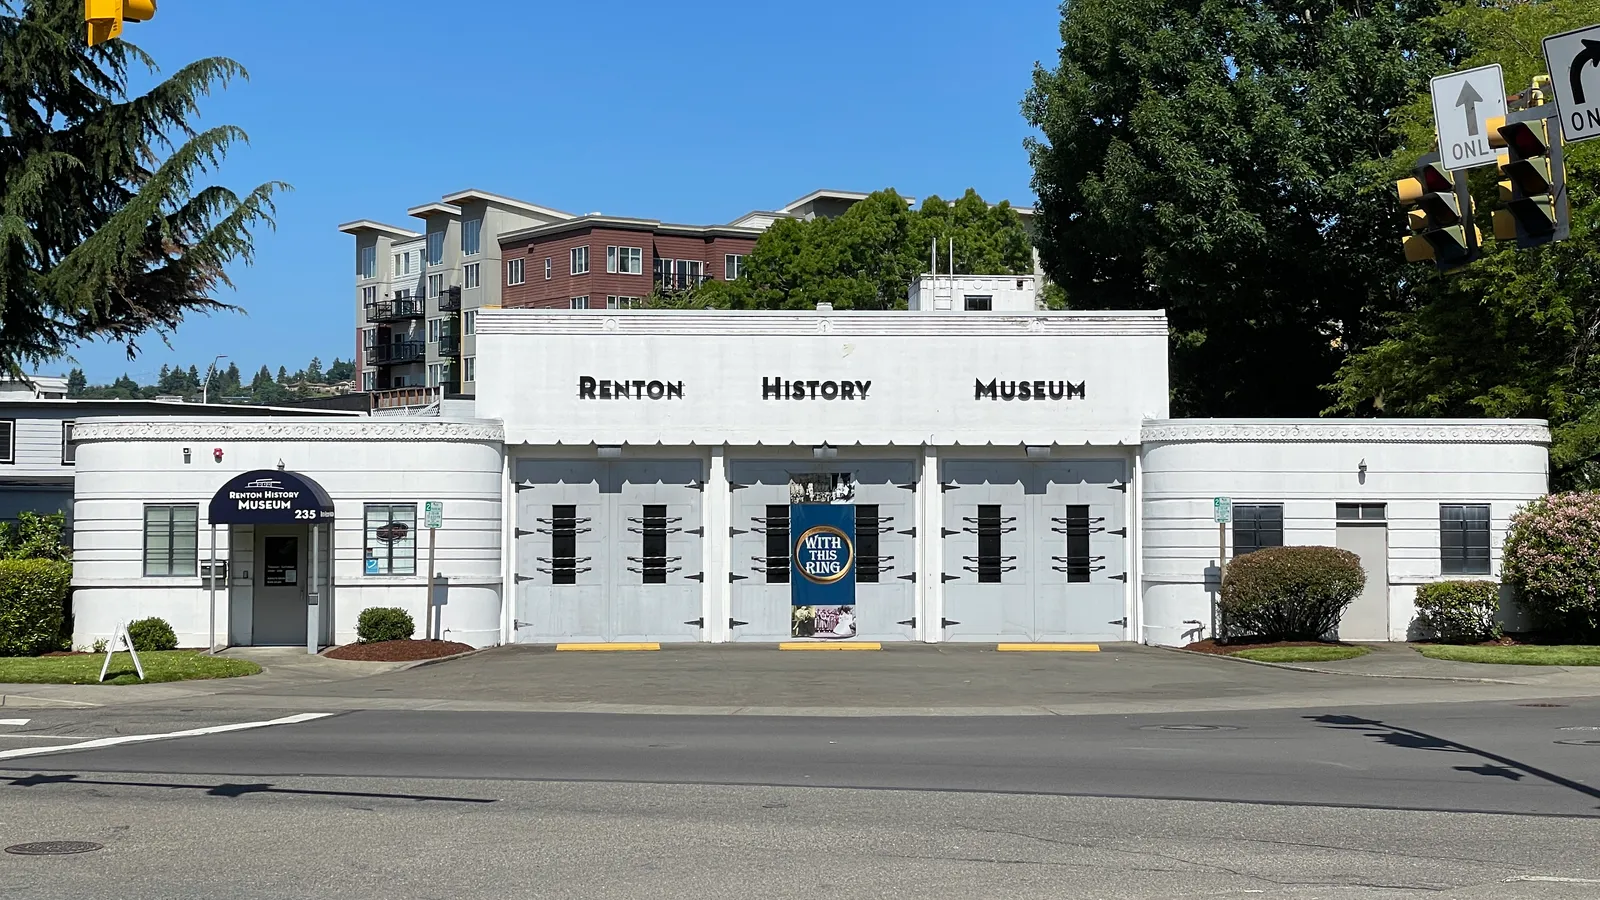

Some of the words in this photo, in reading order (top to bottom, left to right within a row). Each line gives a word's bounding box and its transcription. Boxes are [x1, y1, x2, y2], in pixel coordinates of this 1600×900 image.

[1452, 139, 1496, 160] ONL
[294, 509, 316, 520] 235
[805, 534, 842, 549] WITH
[808, 550, 838, 561] THIS
[805, 561, 841, 574] RING
